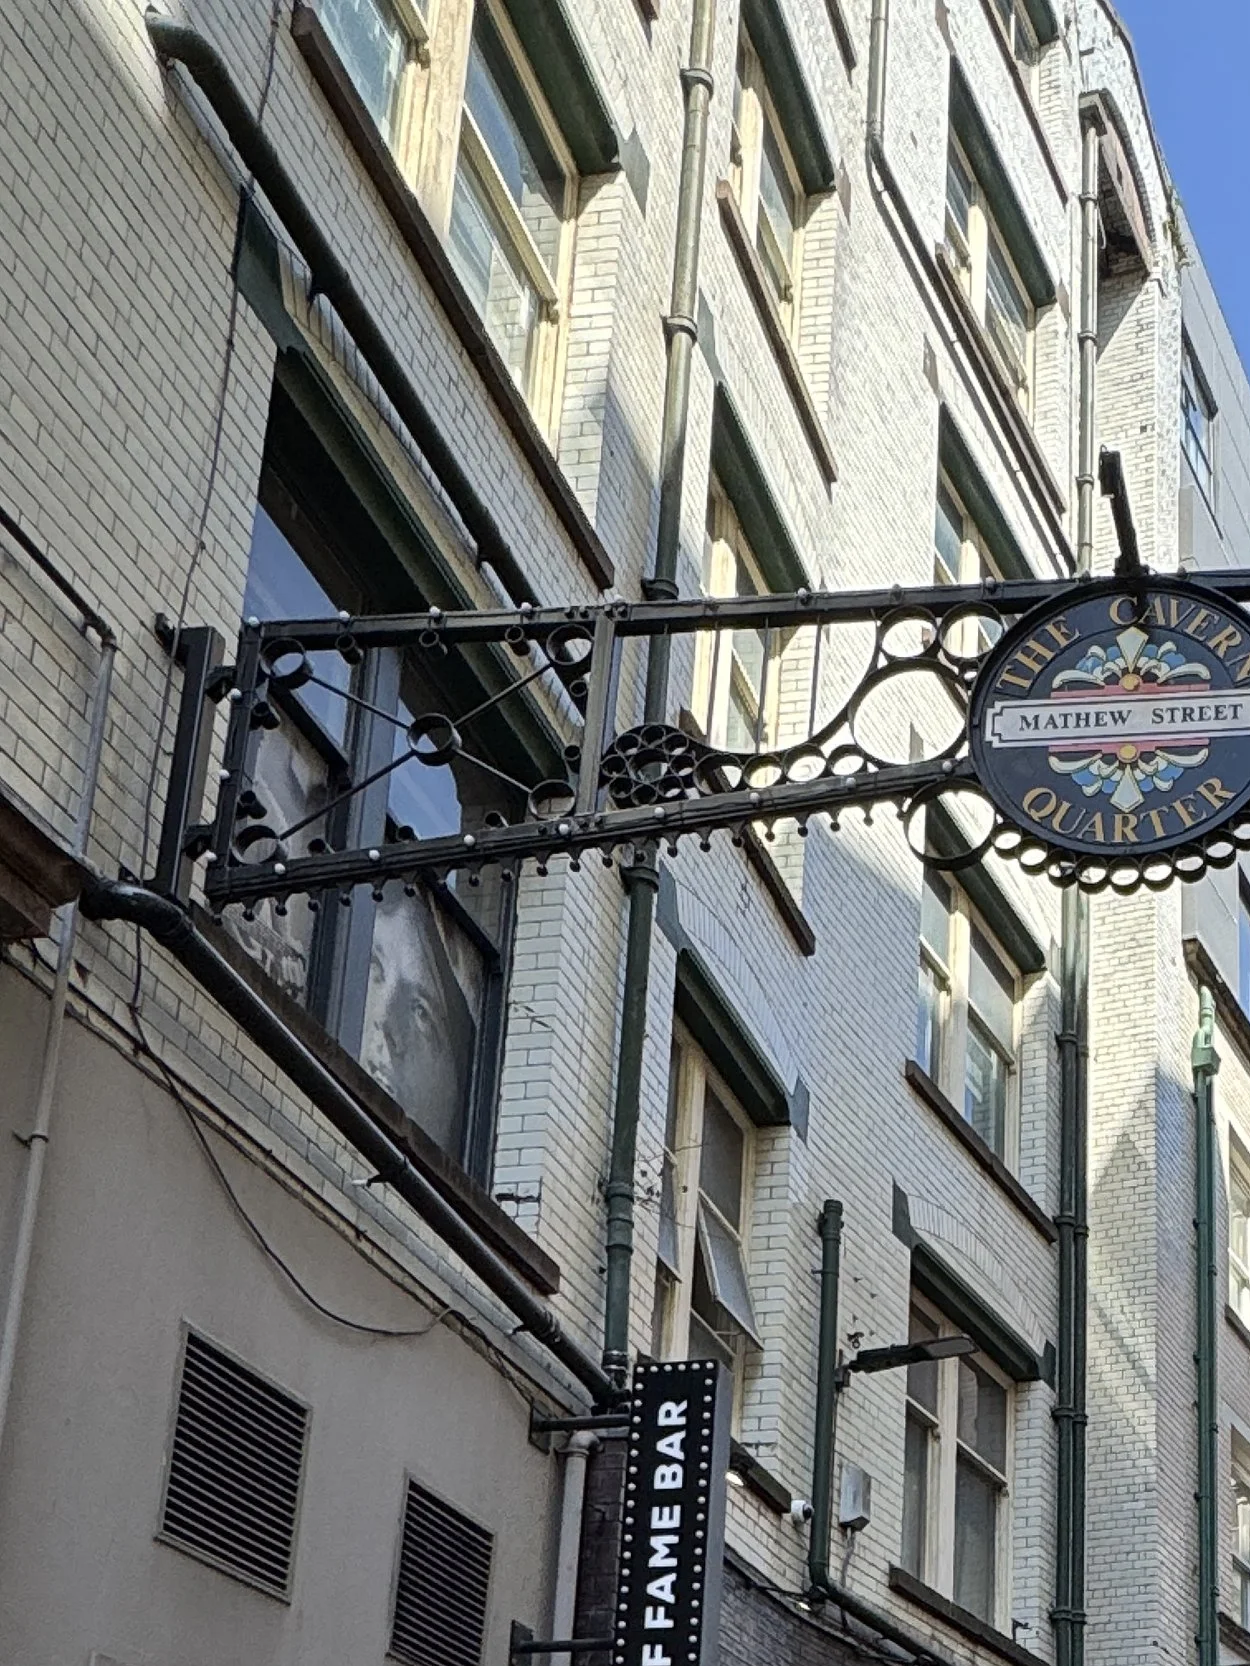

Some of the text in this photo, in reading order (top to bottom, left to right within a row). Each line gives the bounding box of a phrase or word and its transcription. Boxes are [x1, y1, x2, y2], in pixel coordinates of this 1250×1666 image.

[996, 617, 1080, 691] THE
[1018, 702, 1244, 732] MATHEW STREET
[1021, 776, 1237, 843] QUARTER
[652, 1399, 688, 1491] BAR
[643, 1504, 682, 1630] FAME
